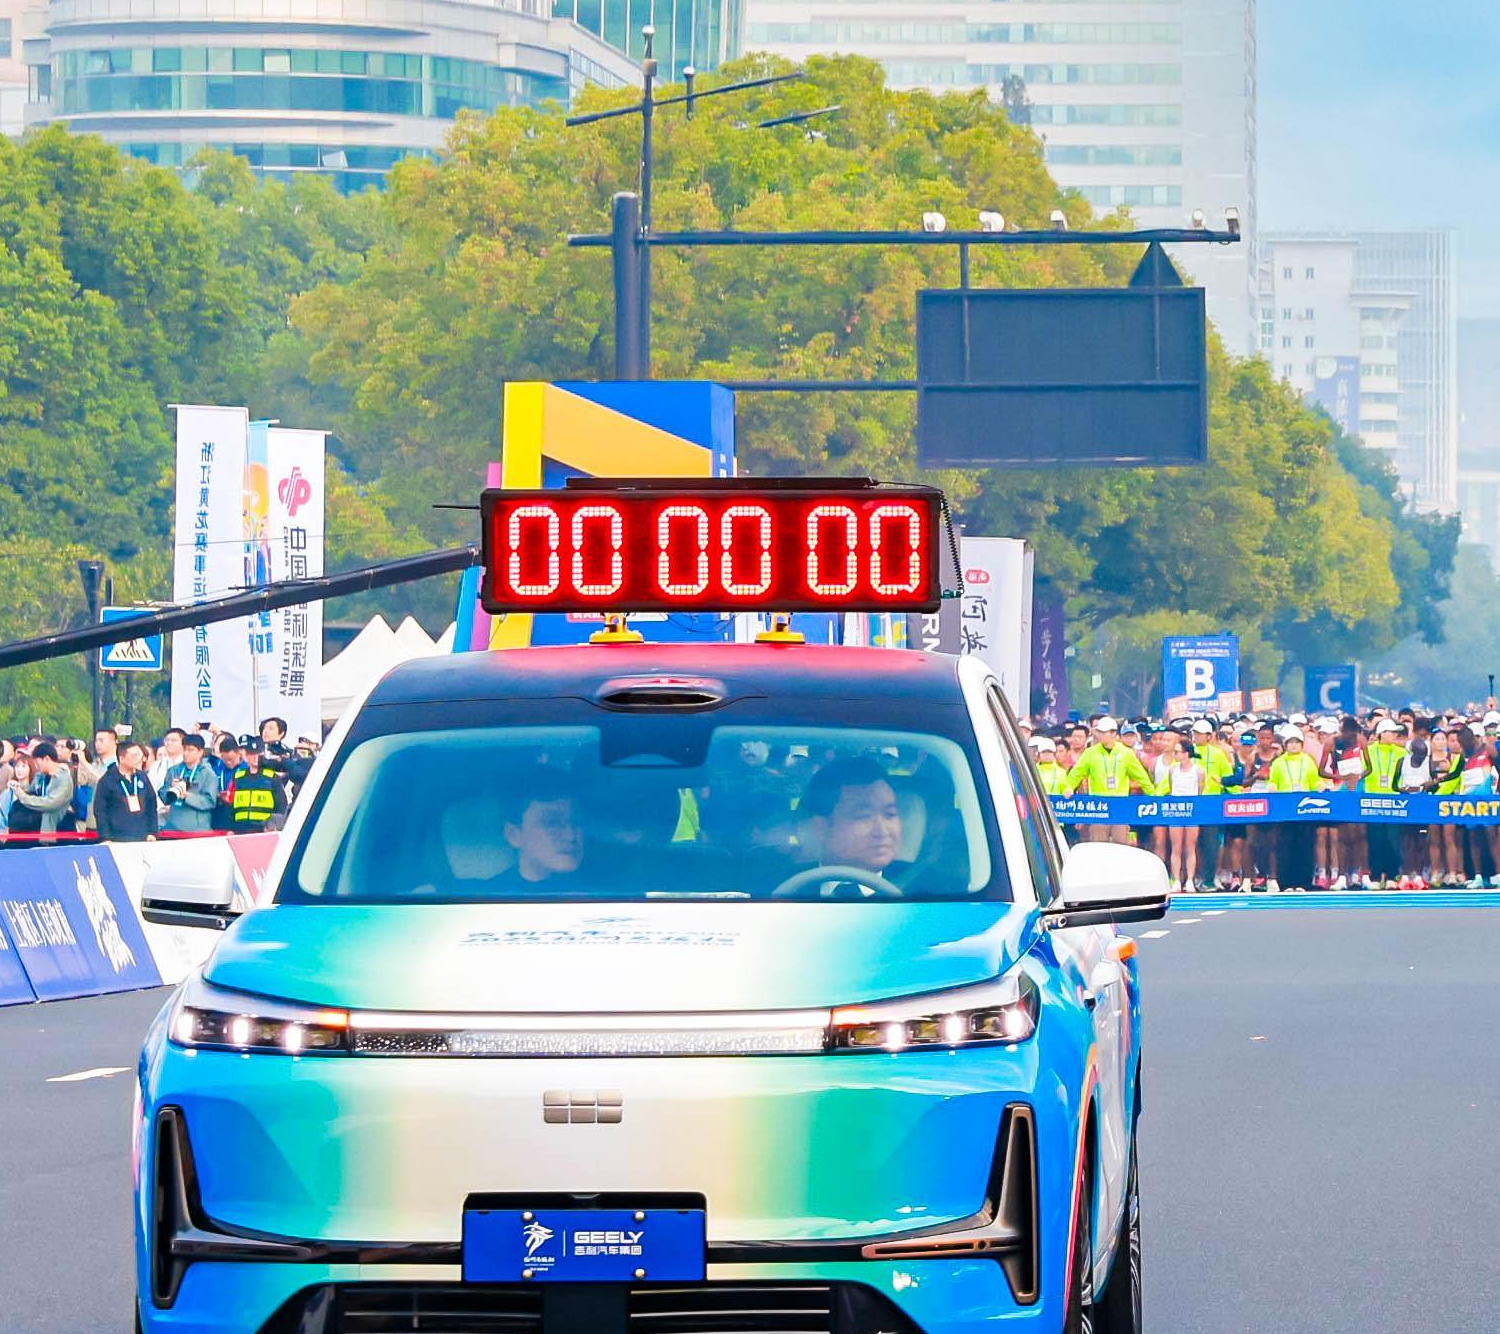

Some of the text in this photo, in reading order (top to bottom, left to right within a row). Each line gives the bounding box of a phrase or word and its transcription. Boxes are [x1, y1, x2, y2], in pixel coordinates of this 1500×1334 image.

[508, 505, 922, 597] 00 00 00
[287, 526, 307, 698] 中国利彩票
[1185, 659, 1216, 701] B
[1319, 680, 1341, 711] C
[1360, 798, 1409, 809] GEELY
[1438, 800, 1500, 818] START
[574, 1231, 644, 1244] GEELY
